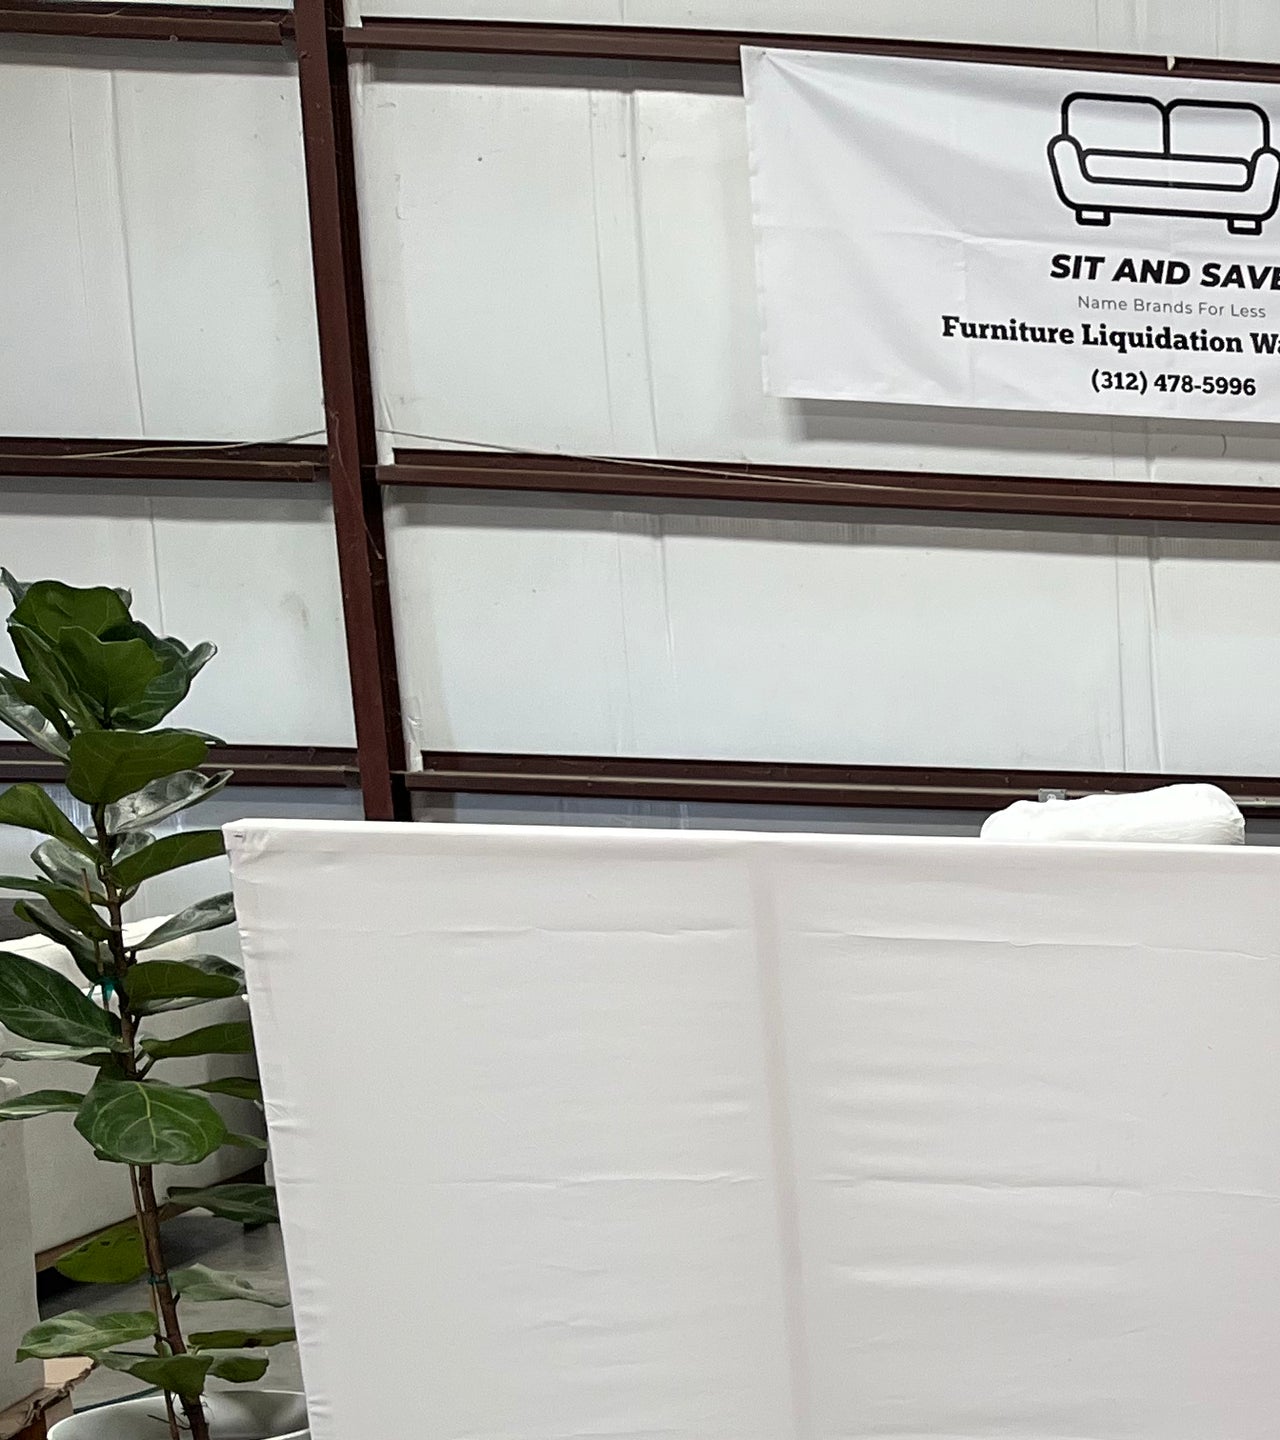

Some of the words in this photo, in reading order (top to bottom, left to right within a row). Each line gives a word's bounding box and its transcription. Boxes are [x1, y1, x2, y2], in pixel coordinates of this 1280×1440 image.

[1049, 253, 1106, 281] SIT
[1111, 257, 1191, 285] AND
[1078, 295, 1128, 311] Name
[1133, 297, 1193, 315] Brands
[1198, 301, 1225, 316] For
[1230, 303, 1266, 318] Less
[941, 315, 1075, 345] Furniture
[1081, 323, 1244, 354] Liquidation
[1091, 368, 1148, 396] (312)
[1153, 373, 1256, 396] 478-5996
